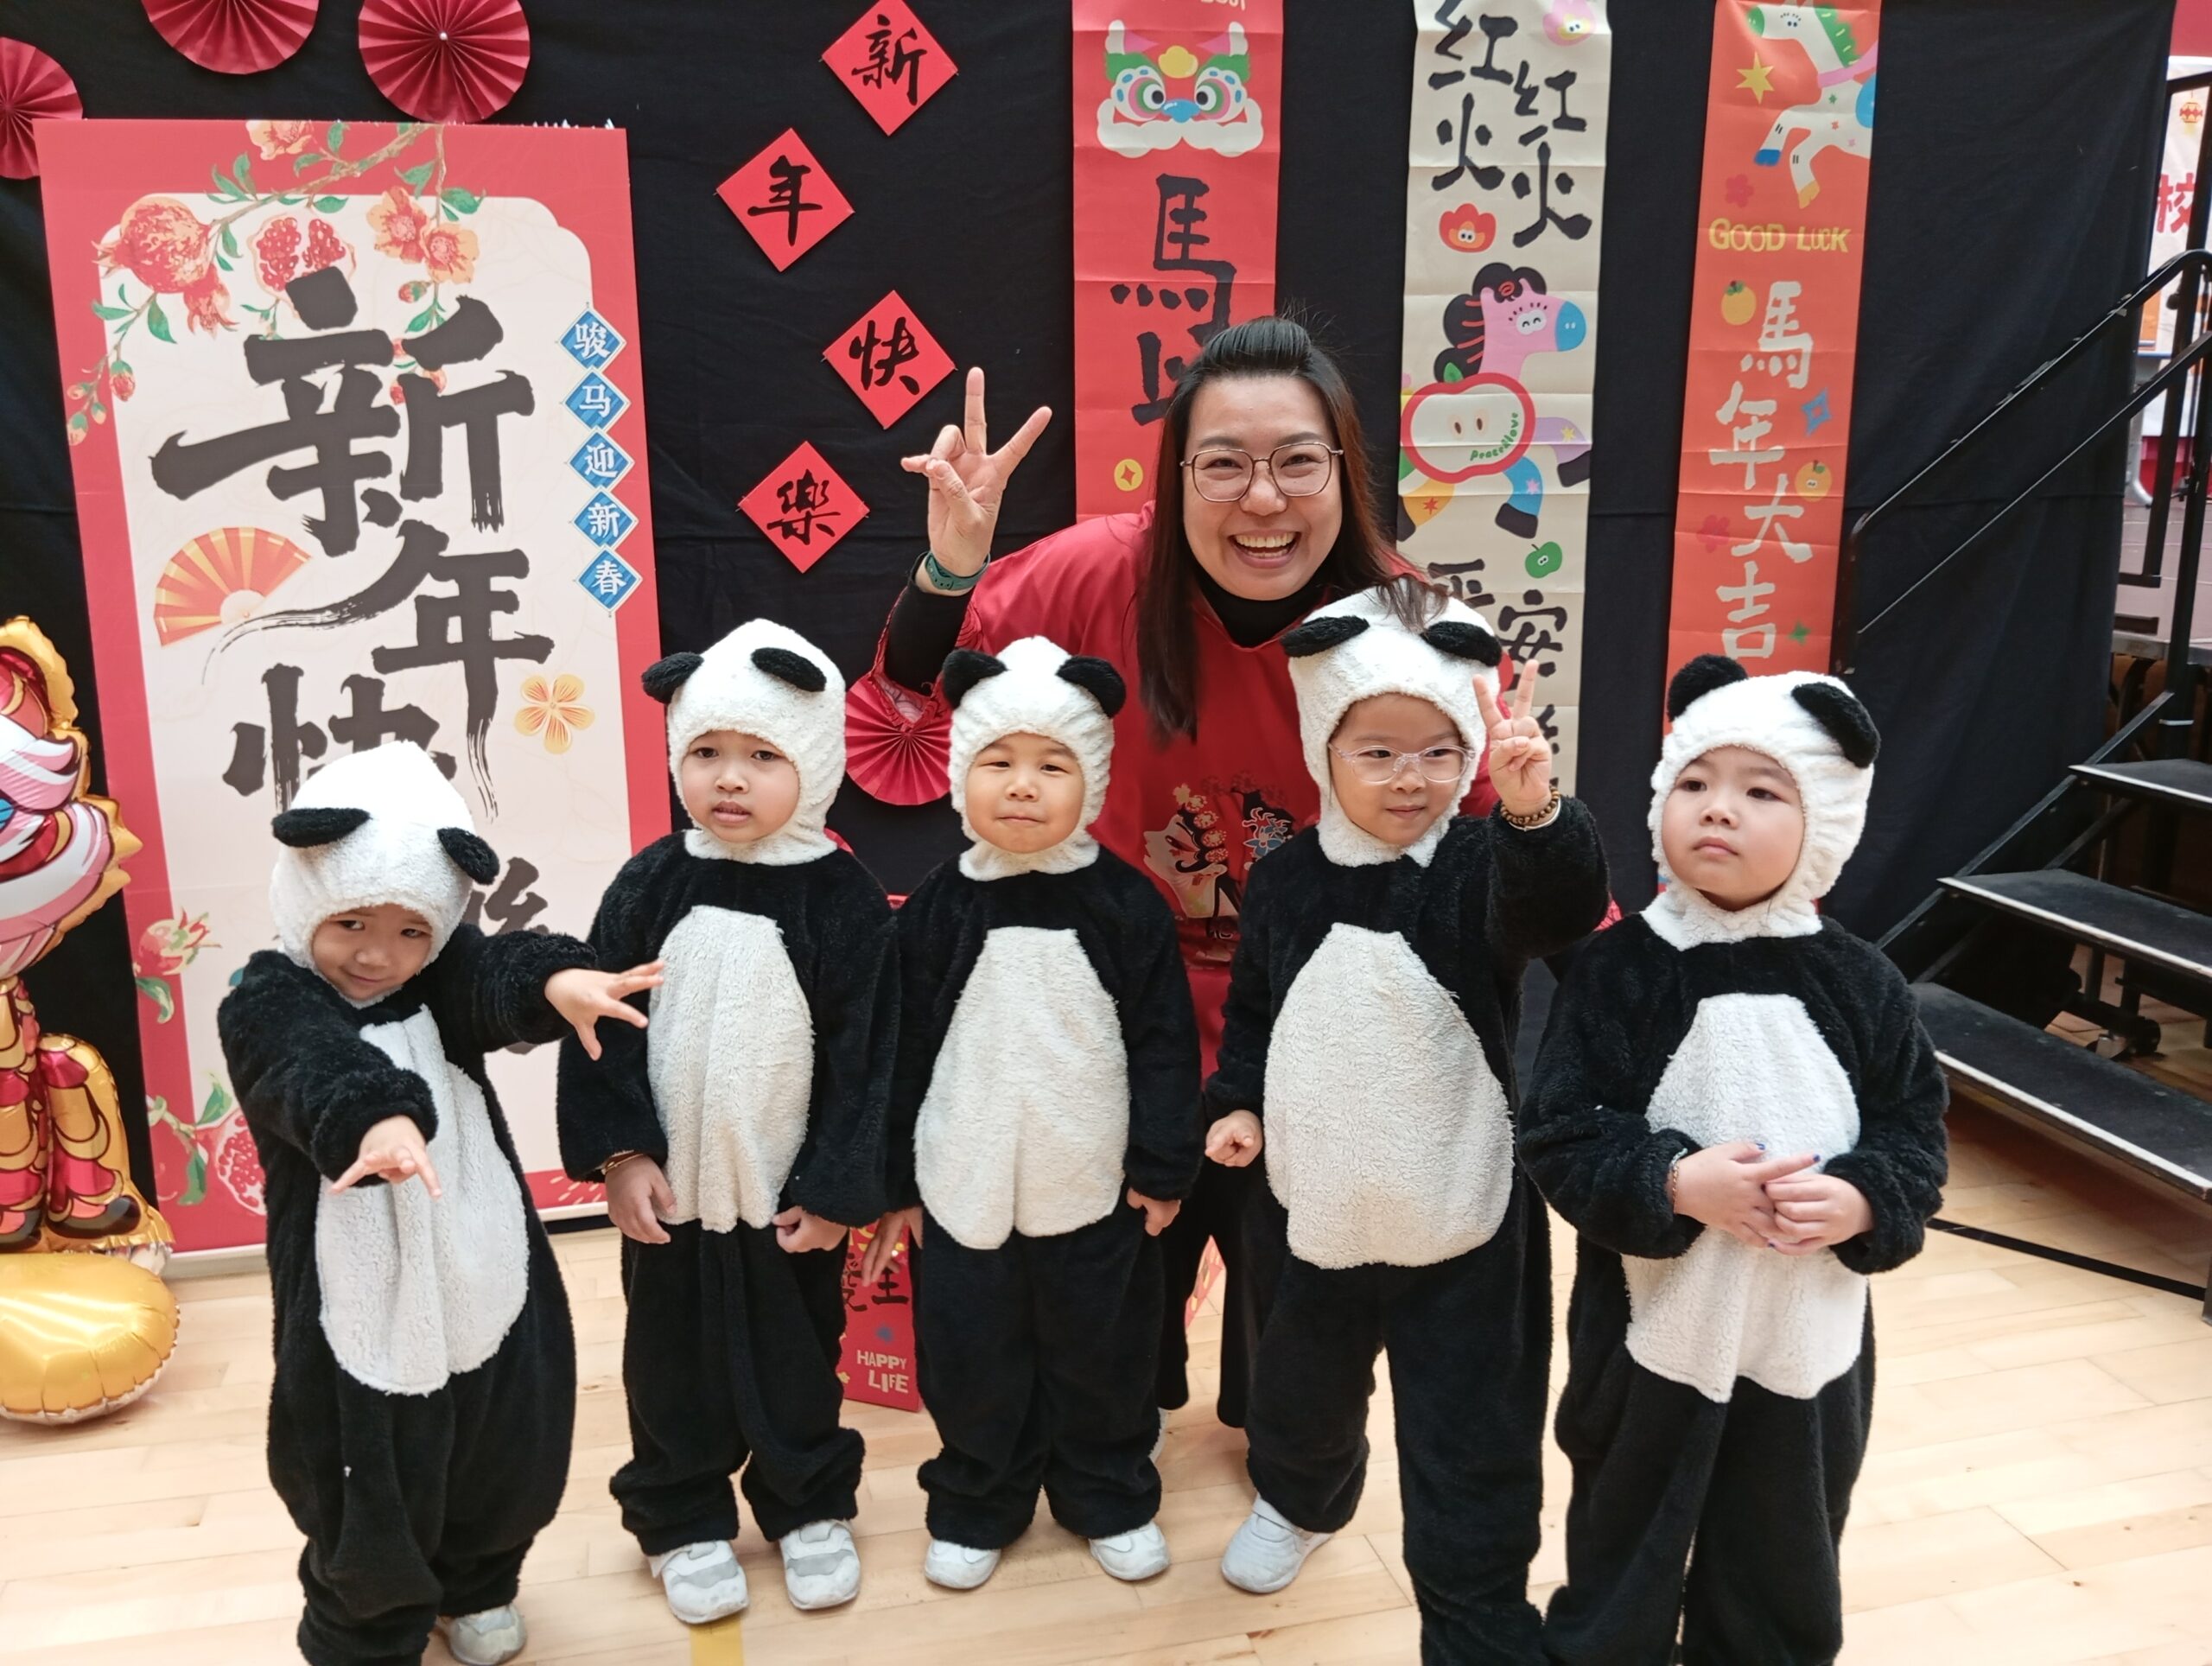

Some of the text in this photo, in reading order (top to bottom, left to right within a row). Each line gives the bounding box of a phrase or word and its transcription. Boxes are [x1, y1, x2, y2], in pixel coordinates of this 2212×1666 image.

[1709, 218, 1786, 252] GOOD
[573, 321, 628, 596] 骏马迎新春
[1708, 280, 1814, 659] 馬年大吉
[149, 266, 556, 1055] 新年快
[857, 1350, 906, 1370] HAPPY
[868, 1369, 909, 1394] LIFE
